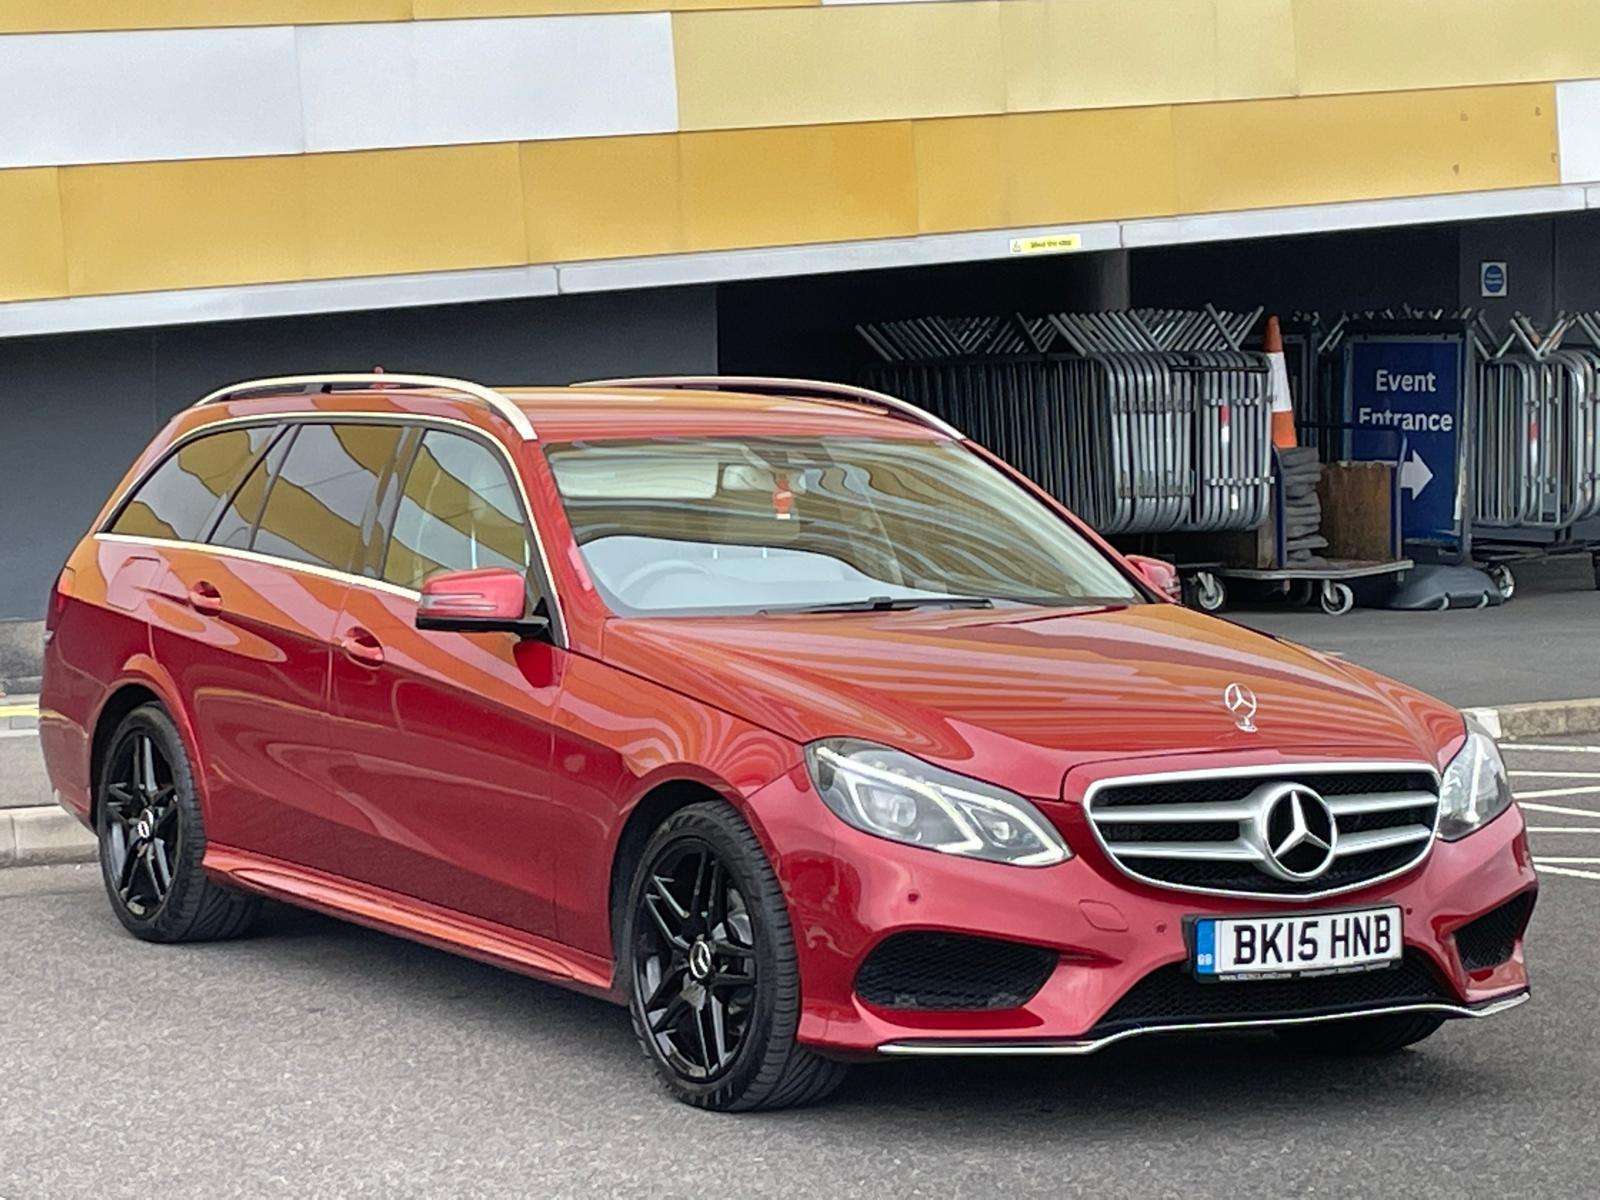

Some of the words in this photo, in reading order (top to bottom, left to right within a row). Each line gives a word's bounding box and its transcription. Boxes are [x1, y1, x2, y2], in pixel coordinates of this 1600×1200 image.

[1376, 369, 1437, 392] Event
[1359, 407, 1453, 431] Entrance
[1233, 921, 1319, 965] BK15
[1330, 914, 1391, 959] HNB
